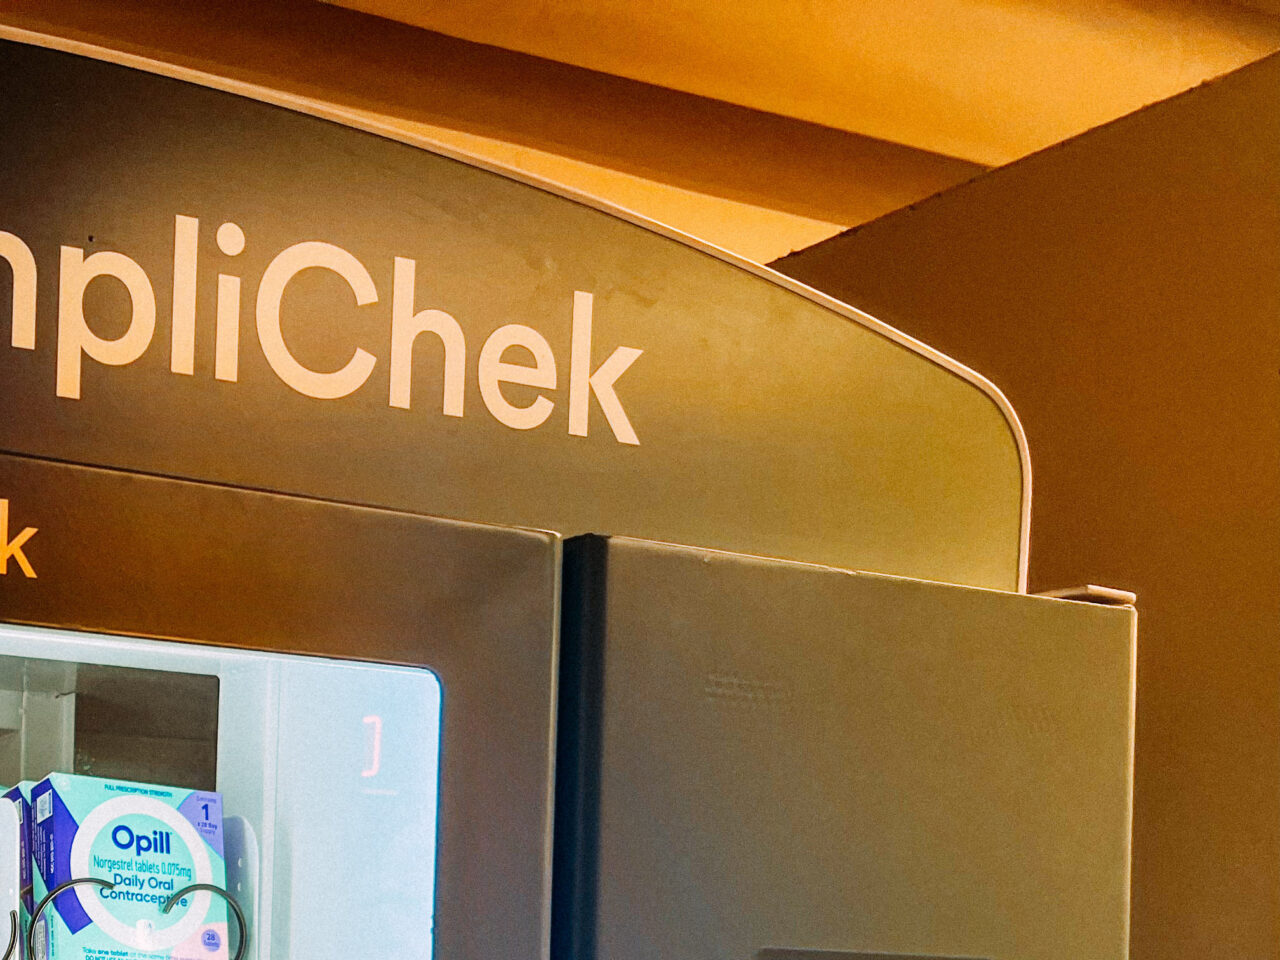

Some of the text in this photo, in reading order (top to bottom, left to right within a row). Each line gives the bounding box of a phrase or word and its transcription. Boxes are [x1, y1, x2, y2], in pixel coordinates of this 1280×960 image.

[201, 803, 209, 821] 1
[111, 824, 171, 857] Opill
[93, 855, 192, 881] Norgestrel tablets 0.075mg
[113, 873, 174, 890] Daily Oral
[206, 933, 216, 941] 28
